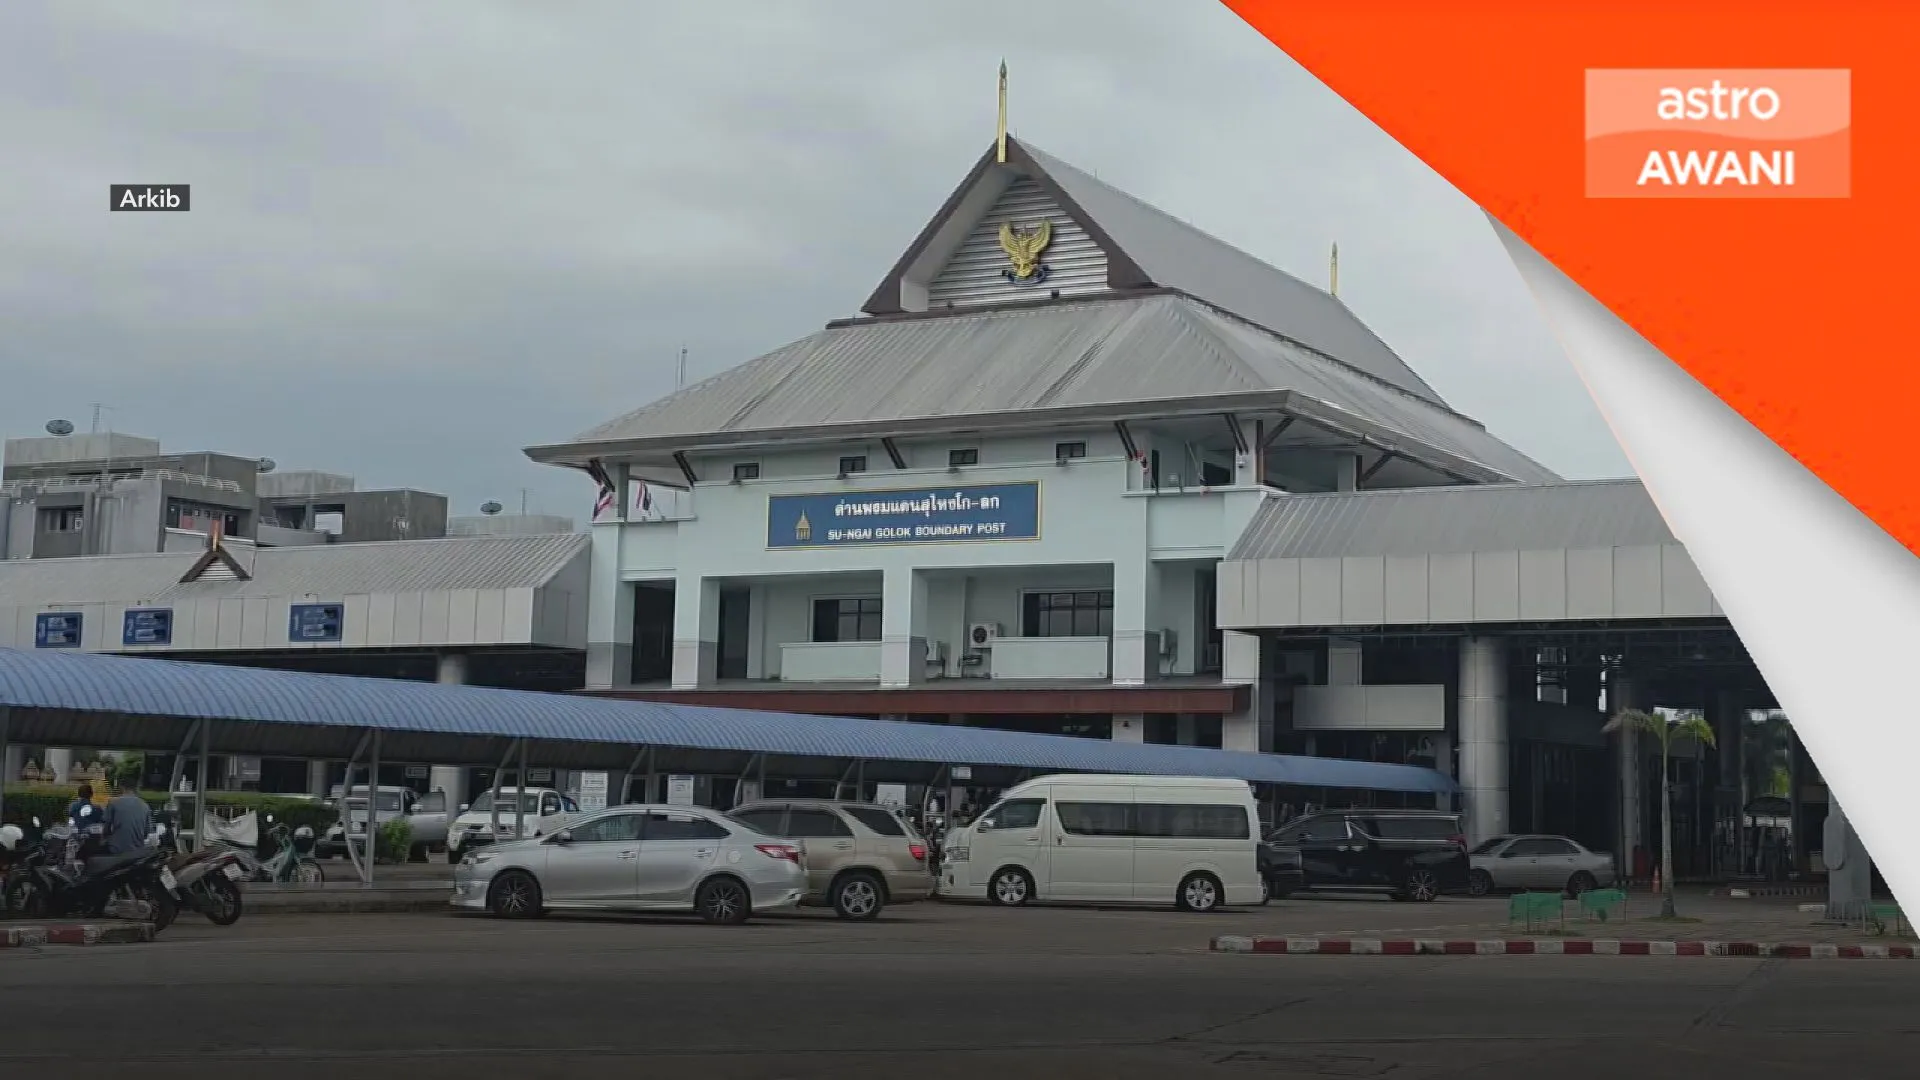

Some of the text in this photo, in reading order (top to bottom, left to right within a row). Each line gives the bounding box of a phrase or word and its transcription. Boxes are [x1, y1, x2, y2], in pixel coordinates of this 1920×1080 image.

[828, 522, 1006, 540] SU-NGAI GOLOK BOUNDARY POST
